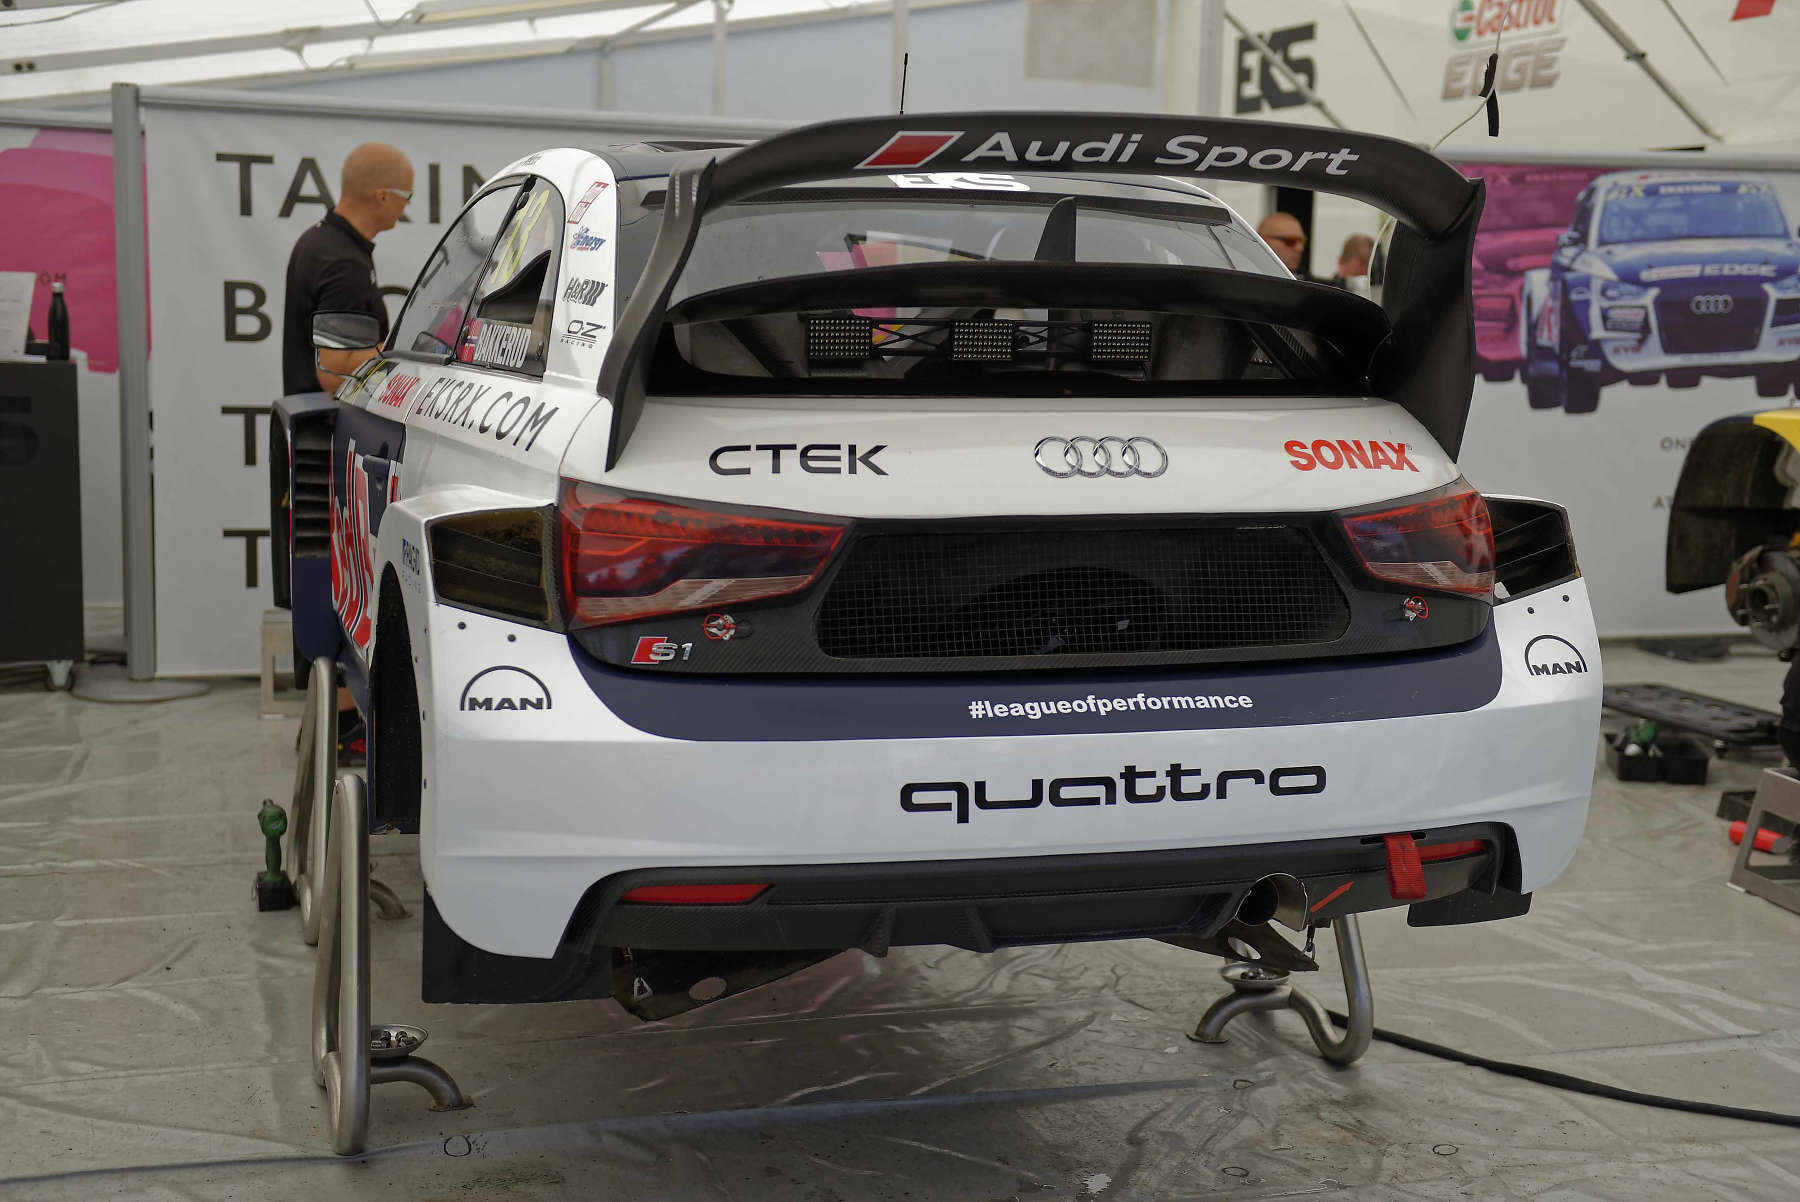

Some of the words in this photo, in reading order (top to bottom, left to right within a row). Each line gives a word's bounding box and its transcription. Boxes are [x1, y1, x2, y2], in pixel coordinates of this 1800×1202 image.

[1235, 23, 1317, 114] EKS
[1440, 38, 1567, 102] EDGE
[961, 131, 1143, 162] Audi
[1155, 134, 1360, 176] Sport
[887, 172, 1031, 192] EKS
[1703, 263, 1779, 278] EDGE
[474, 323, 532, 368] BAKKERUD
[560, 338, 593, 349] RACING
[415, 377, 560, 452] EKSRX.COM
[709, 443, 889, 476] CTEK
[1284, 439, 1420, 472] SONAX
[649, 642, 693, 661] S1
[1532, 661, 1582, 675] MAN
[468, 697, 544, 711] MAN
[969, 693, 1253, 719] #leagueofperformance
[900, 763, 1326, 824] quattro
